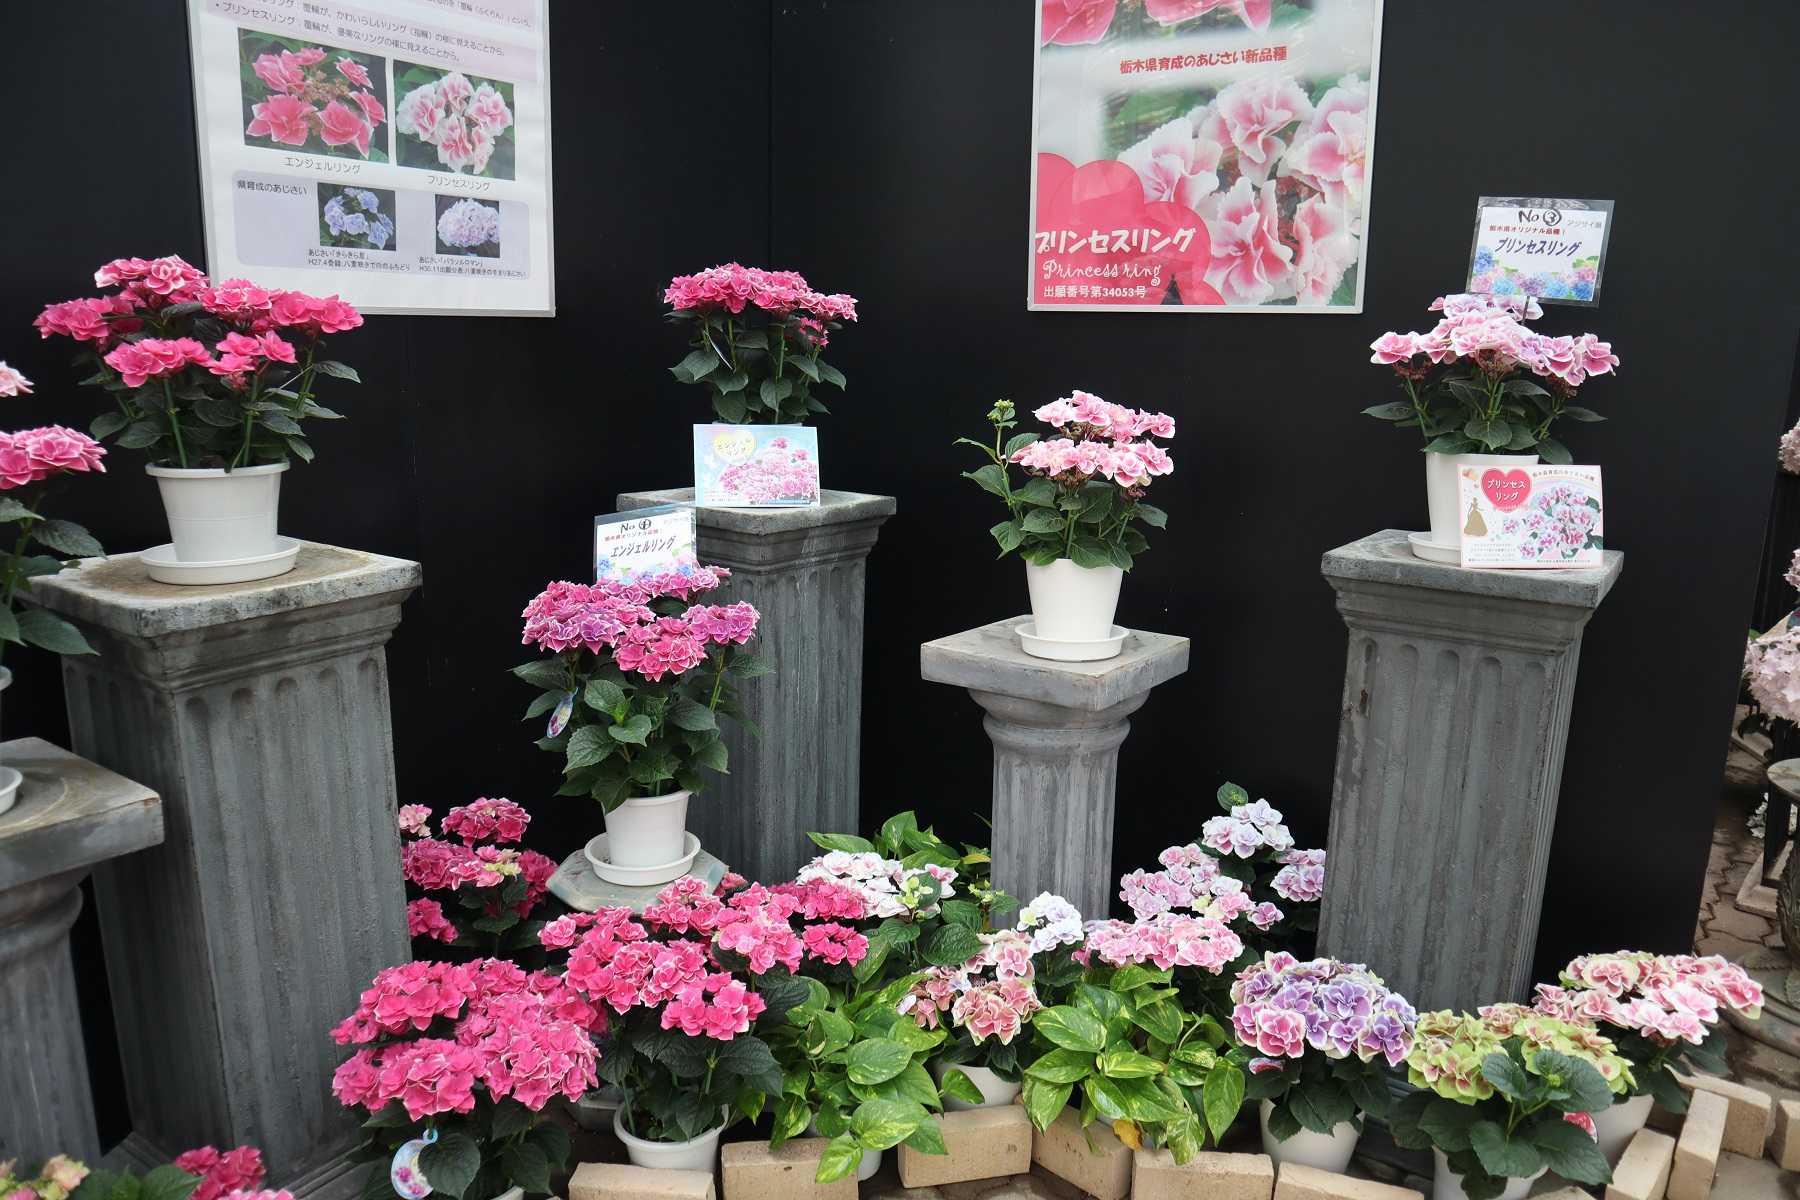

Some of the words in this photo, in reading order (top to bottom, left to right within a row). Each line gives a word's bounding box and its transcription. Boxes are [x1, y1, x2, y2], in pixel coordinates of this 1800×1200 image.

[1119, 46, 1288, 74] 栃木県育成のあじさい新品種
[285, 157, 361, 174] エンジェルリング
[237, 180, 308, 195] 県育成のあじさい
[427, 175, 490, 191] プリンセスリング
[1035, 228, 1197, 254] プリンセスリング
[1494, 236, 1583, 257] プリンセスリング
[1043, 259, 1119, 280] Princess
[1121, 263, 1162, 287] ring
[1043, 285, 1148, 298] 出願番号第34053号
[1487, 479, 1527, 490] プリンセス
[1495, 491, 1520, 501] リング
[610, 535, 677, 558] エンジェルリング
